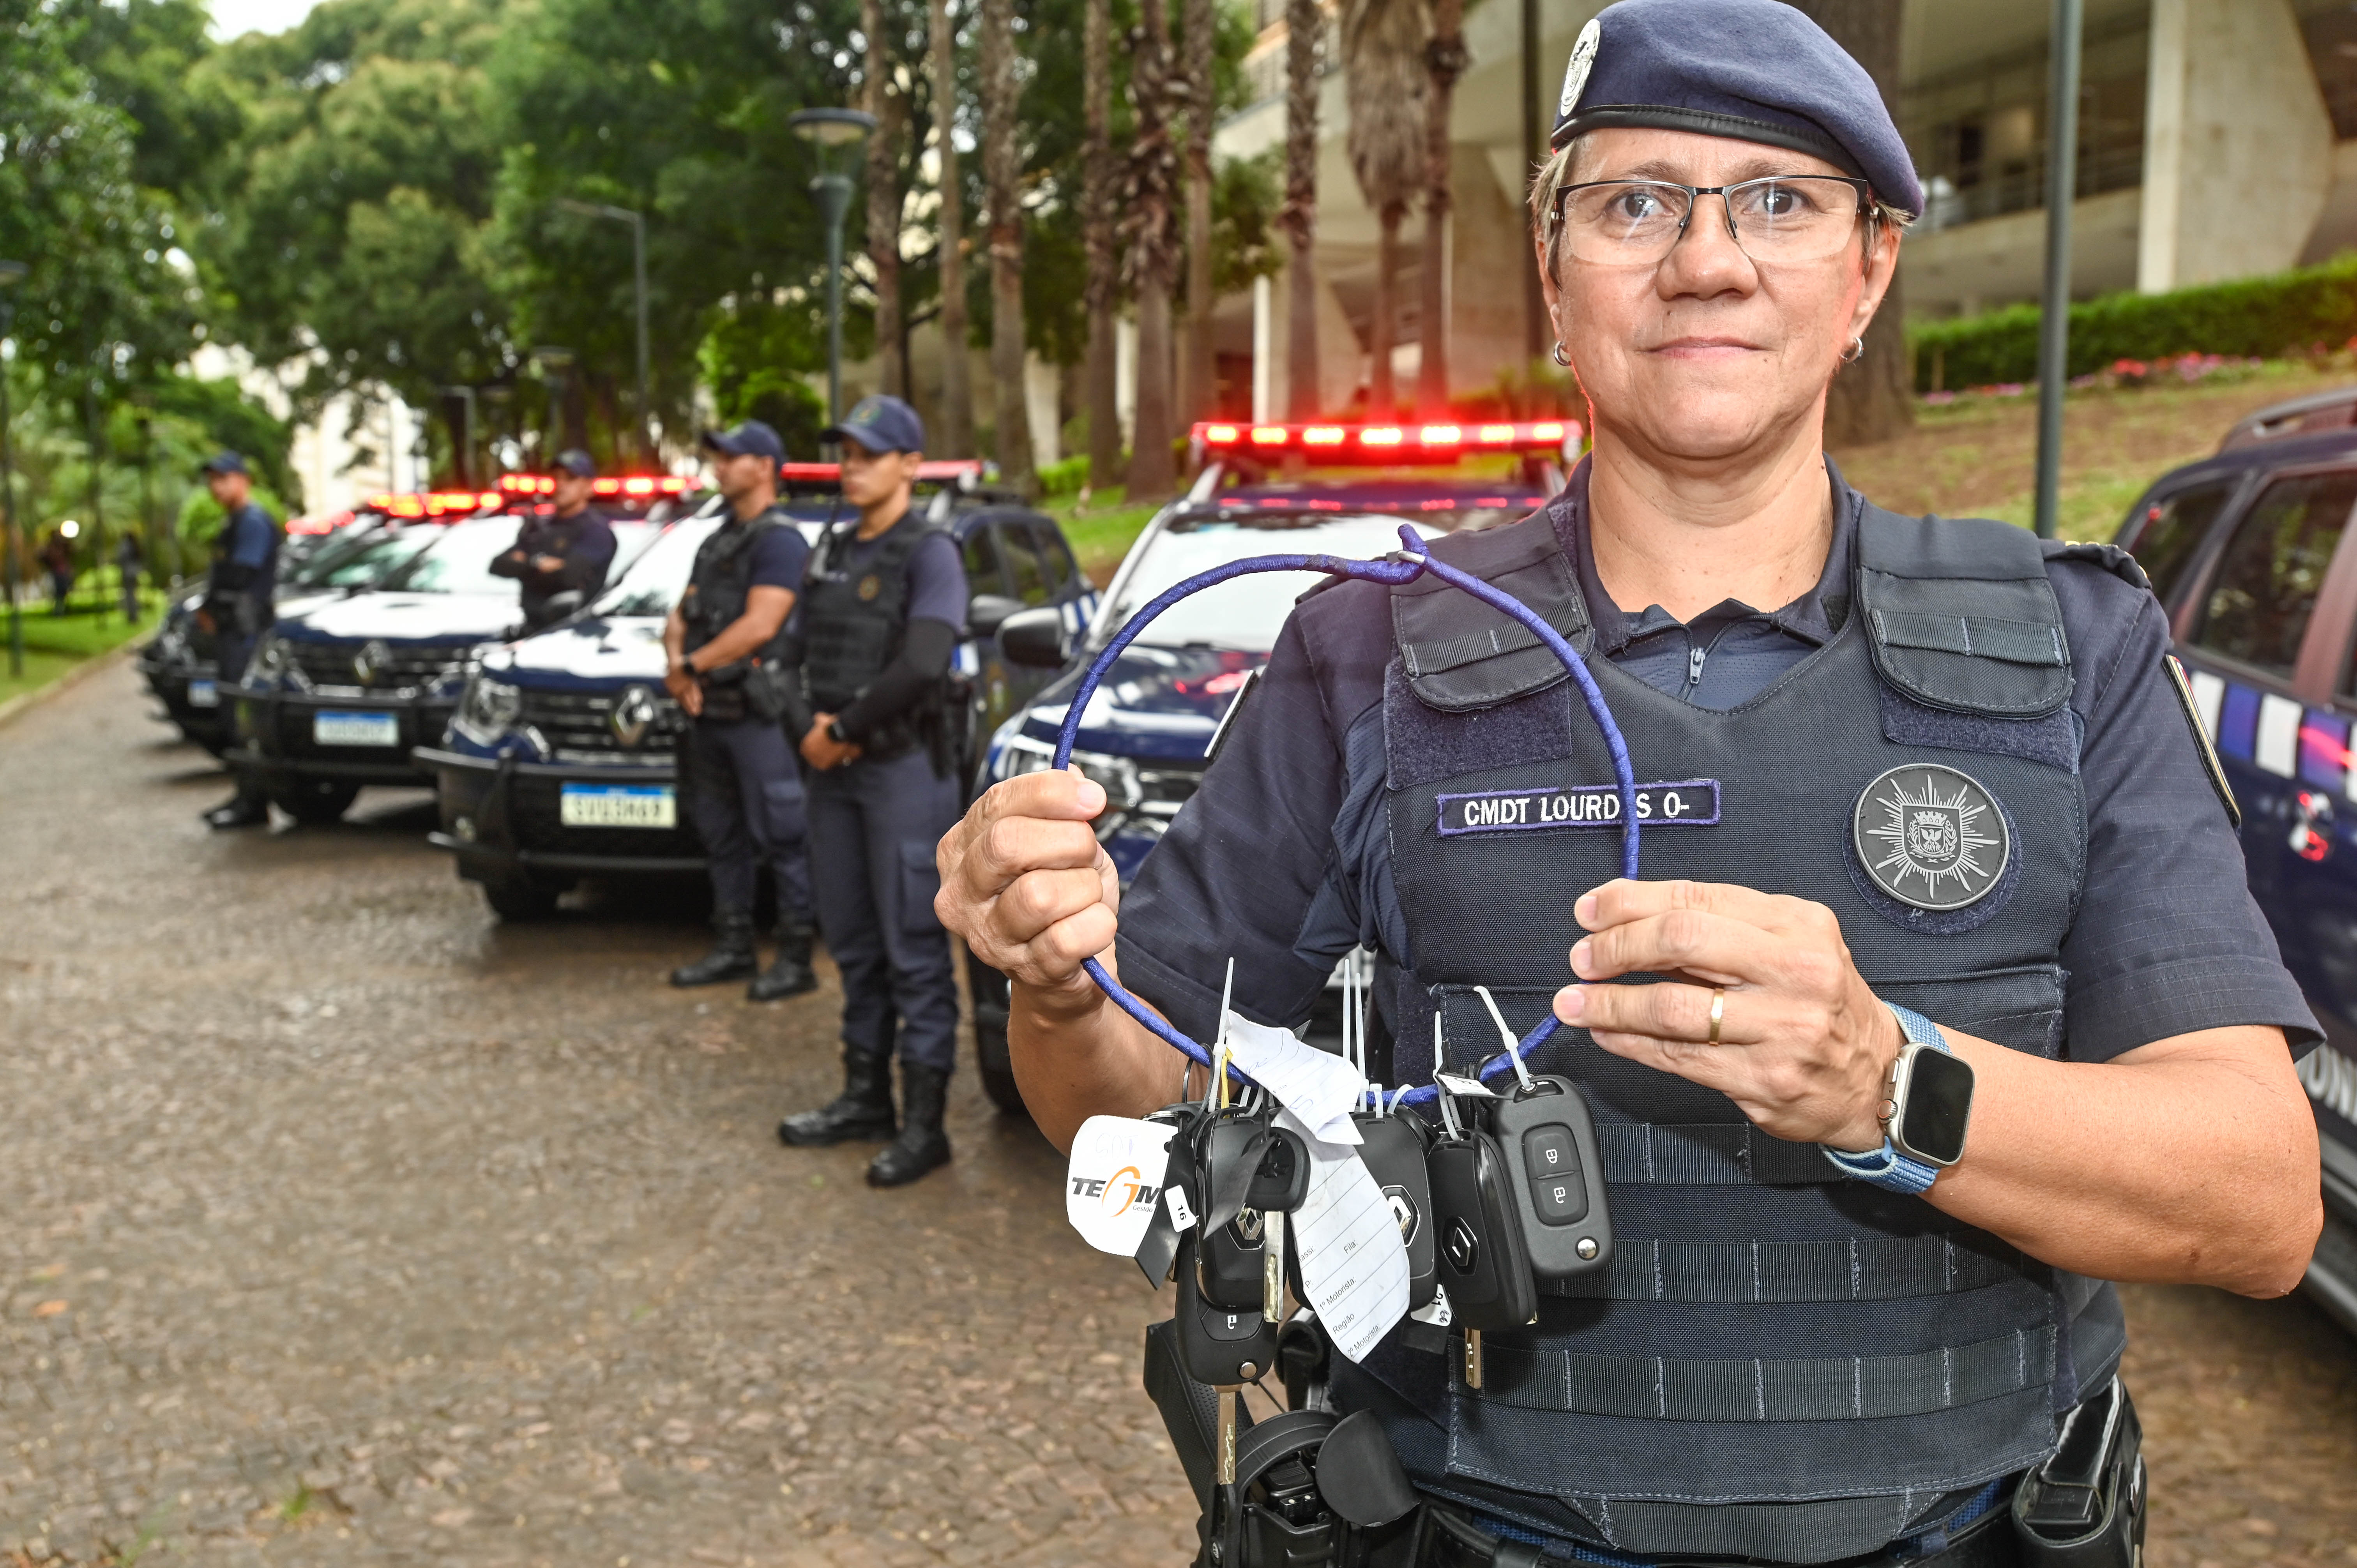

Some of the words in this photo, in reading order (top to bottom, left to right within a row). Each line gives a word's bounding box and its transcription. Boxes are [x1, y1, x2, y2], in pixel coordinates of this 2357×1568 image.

[1464, 798, 1530, 825] CMDT
[1539, 792, 1652, 822] LOURDS
[1178, 1204, 1186, 1220] 16
[1344, 1240, 1358, 1254] Fila:
[1305, 1280, 1314, 1289] P:
[1326, 1277, 1357, 1305] Motorista:
[1332, 1314, 1355, 1334] Região
[1347, 1347, 1354, 1358] 2º
[1354, 1324, 1381, 1351] Motorista:
